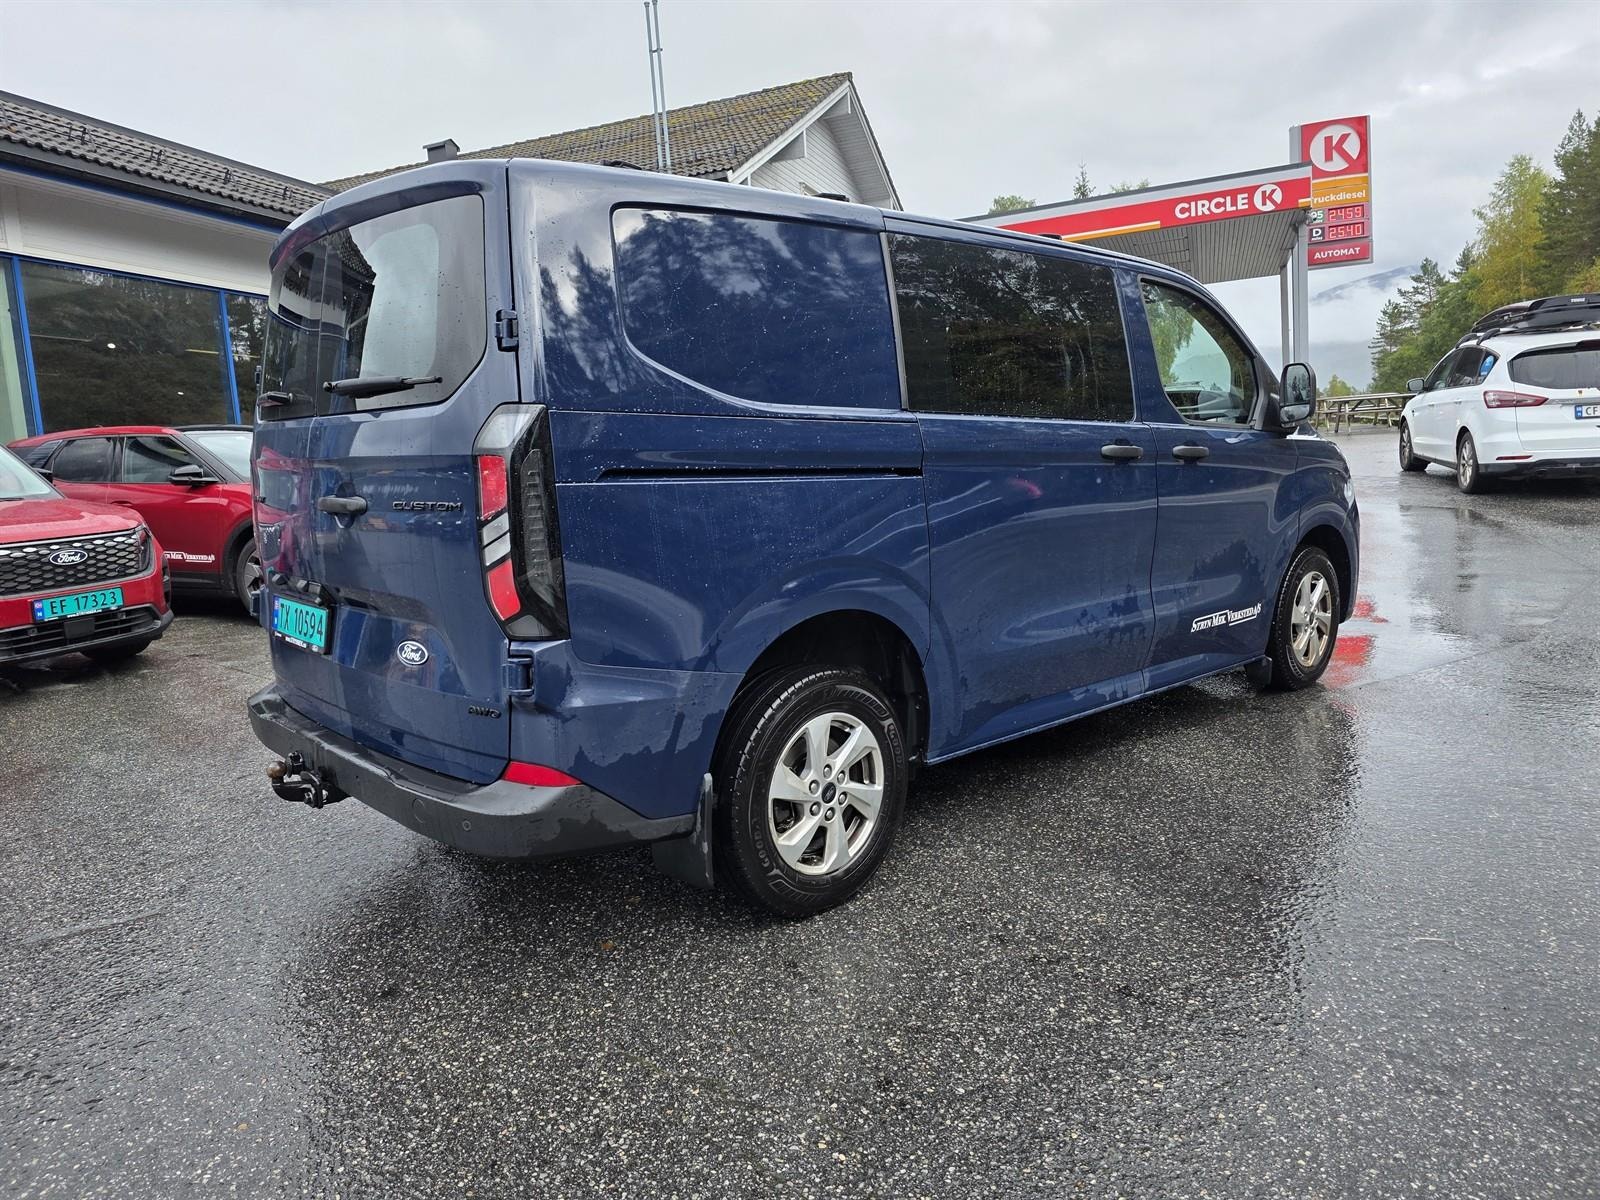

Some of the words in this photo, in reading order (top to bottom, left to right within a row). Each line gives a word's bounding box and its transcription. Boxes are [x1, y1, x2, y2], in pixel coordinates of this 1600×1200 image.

[1311, 190, 1366, 204] ruckdiesel
[1174, 193, 1249, 219] CIRCLE
[1312, 228, 1322, 237] D
[1313, 247, 1361, 259] AUTOMAT
[1585, 406, 1598, 416] CF
[392, 500, 464, 511] CUSTOM
[50, 599, 67, 615] EF
[74, 591, 117, 611] 17323
[280, 603, 291, 630] TX
[294, 607, 323, 642] 10594
